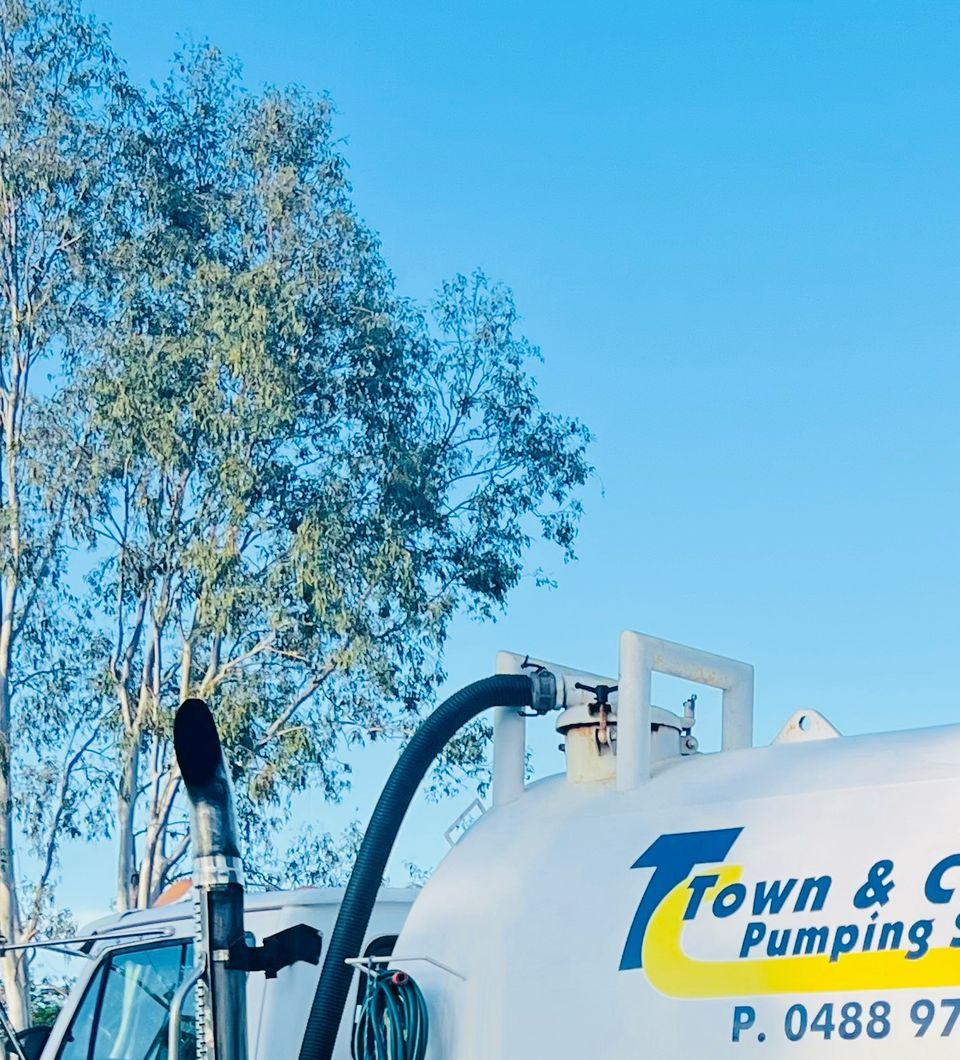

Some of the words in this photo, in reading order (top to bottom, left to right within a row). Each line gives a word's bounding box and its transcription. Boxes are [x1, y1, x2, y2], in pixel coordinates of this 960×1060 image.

[684, 875, 832, 921] Town
[853, 859, 896, 909] &
[739, 912, 935, 963] Pumping
[731, 1005, 767, 1042] P.
[784, 1001, 892, 1041] 0488
